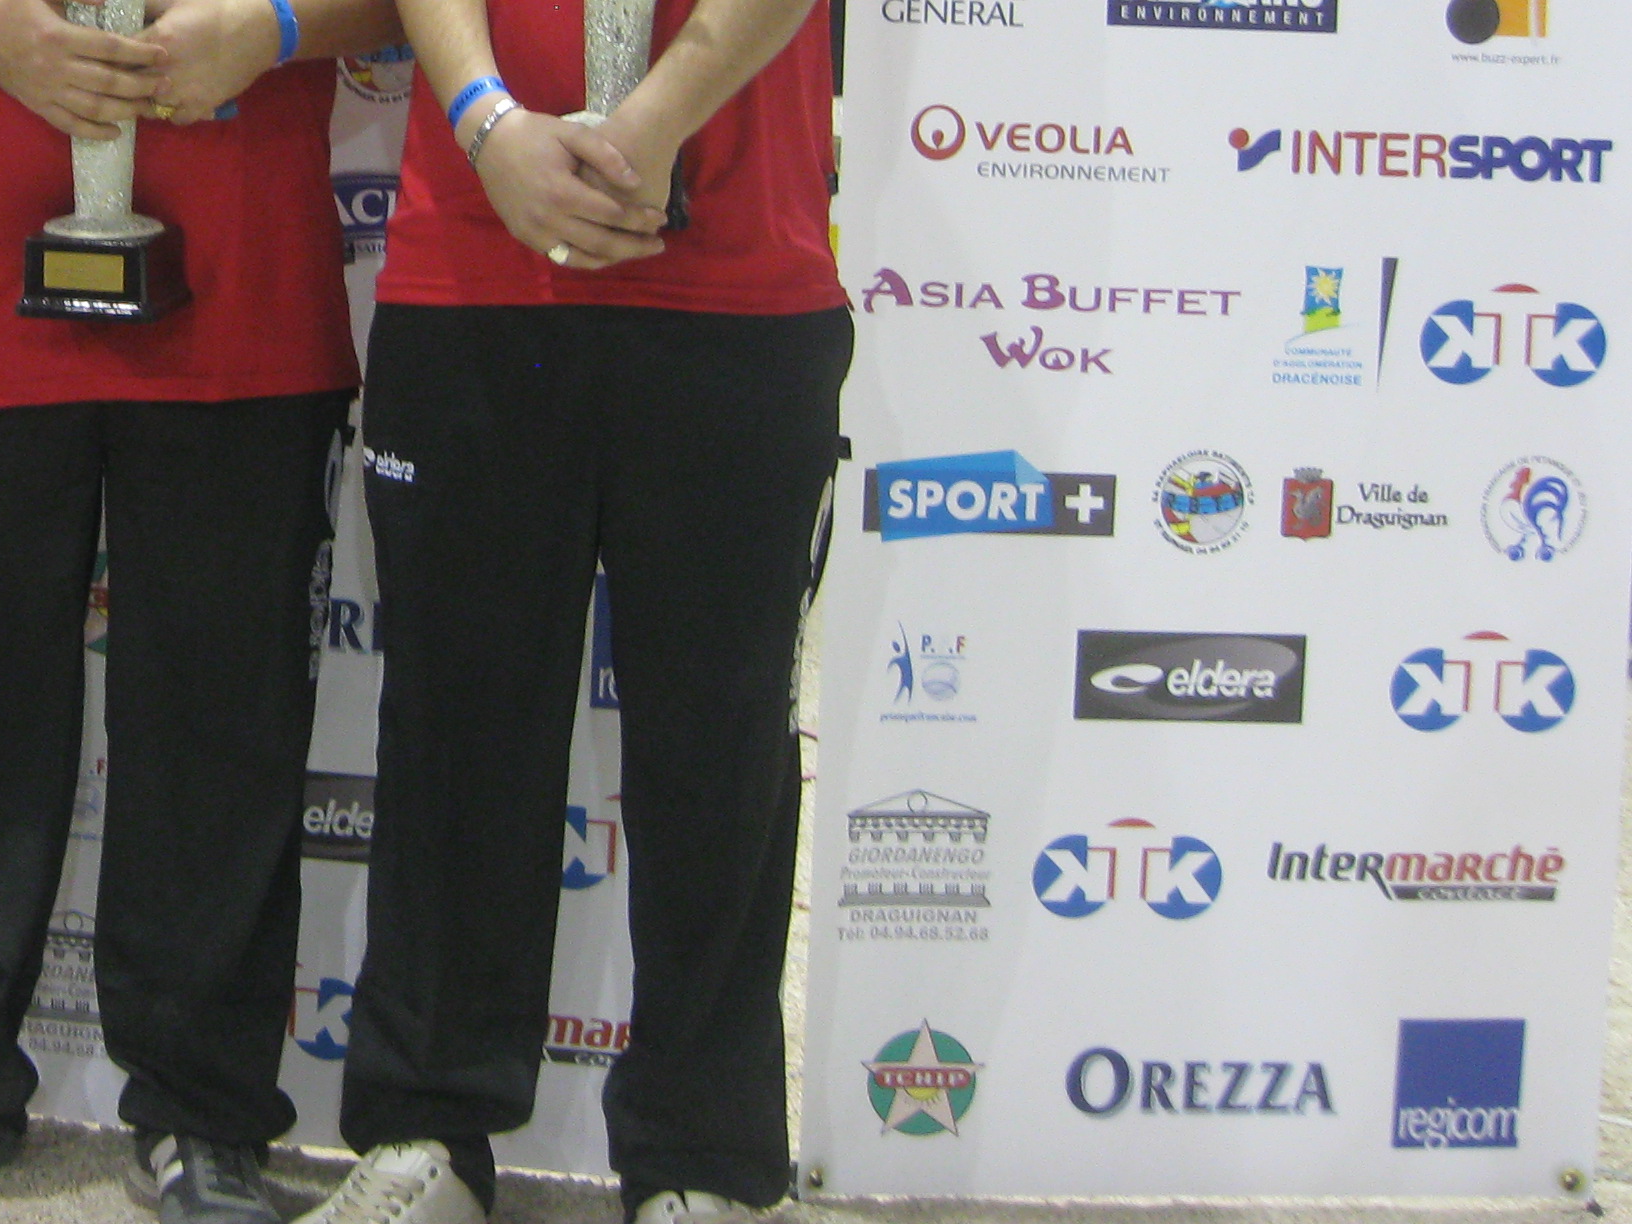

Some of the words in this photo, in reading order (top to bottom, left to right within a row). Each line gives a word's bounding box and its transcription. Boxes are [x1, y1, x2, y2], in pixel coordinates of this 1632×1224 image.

[1120, 4, 1325, 26] ENVIRONNEMENT
[976, 121, 1135, 158] VEOLIA
[1290, 128, 1614, 184] INTERSPORT
[976, 161, 1172, 184] ENVIRONNEMENT
[862, 267, 1003, 314] ASIA
[1020, 273, 1242, 317] BUFFET
[979, 325, 1114, 375] WOK
[887, 481, 1045, 524] SPORT
[1357, 482, 1405, 504] Ville
[1408, 483, 1429, 504] de
[1335, 505, 1448, 531] Draguignan
[1166, 659, 1277, 701] eldera
[1266, 841, 1566, 900] Intermarché
[850, 908, 977, 923] DRAGUIGNAN
[1066, 1047, 1334, 1116] OREZZA
[1398, 1095, 1520, 1148] regicom
